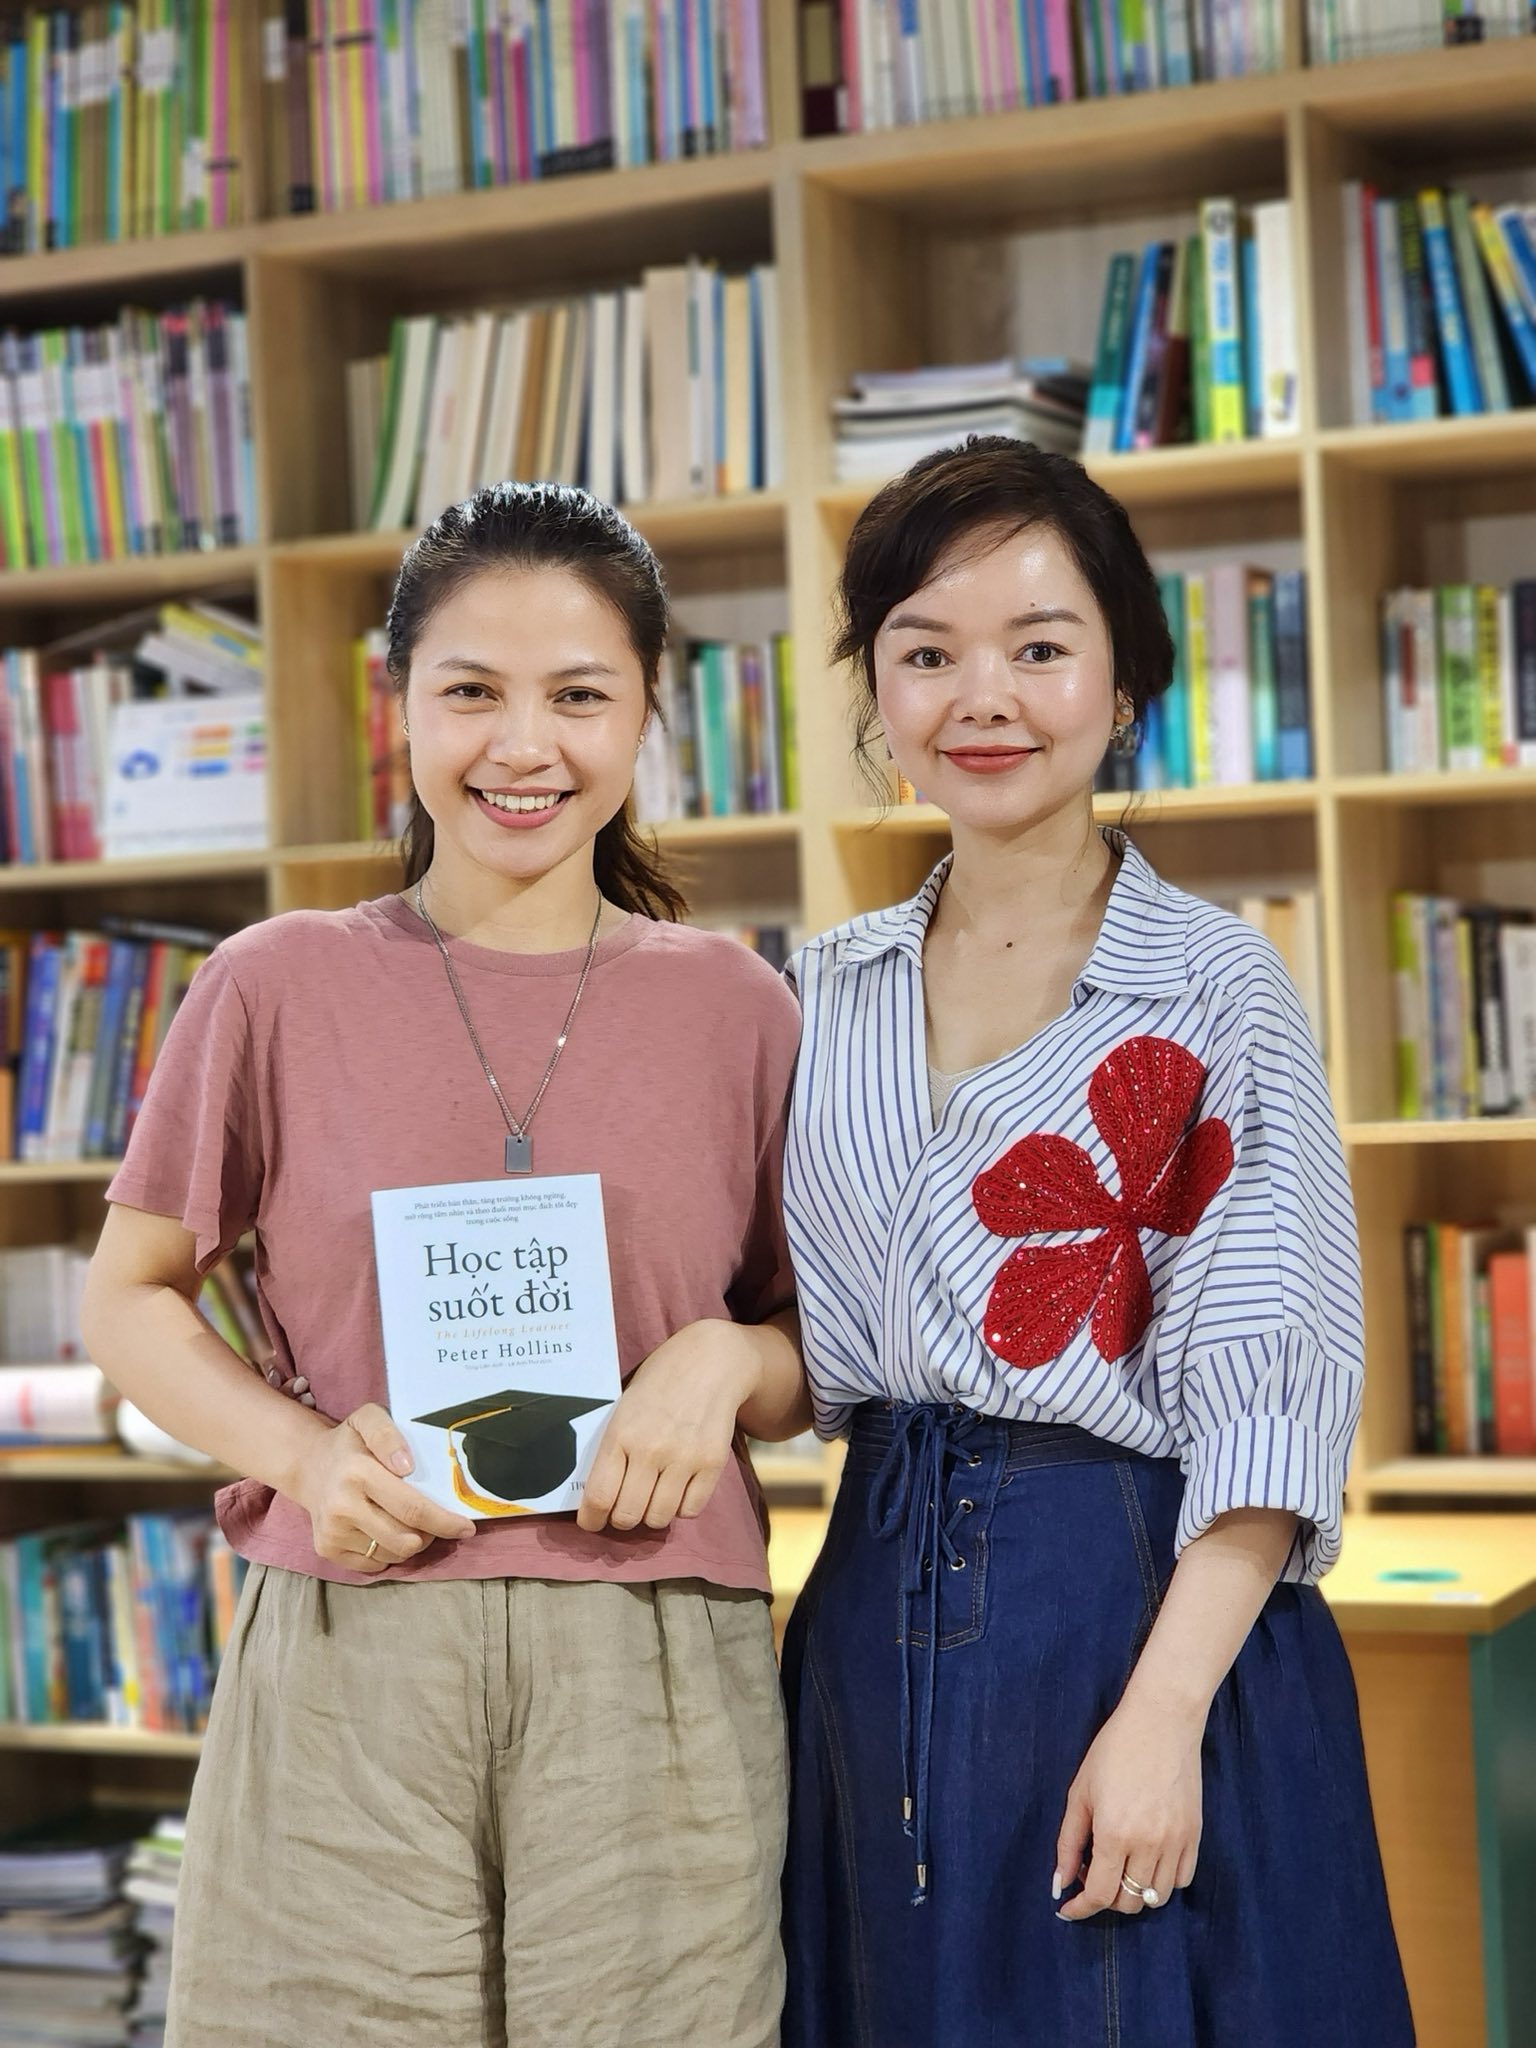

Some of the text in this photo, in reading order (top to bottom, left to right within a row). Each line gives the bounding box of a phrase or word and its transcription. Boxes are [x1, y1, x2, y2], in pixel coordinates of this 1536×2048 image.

[423, 1237, 568, 1279] Học tập
[429, 1279, 573, 1322] suốt đời
[436, 1322, 571, 1340] The Lifelong Learner
[437, 1340, 573, 1363] Peter Hollins
